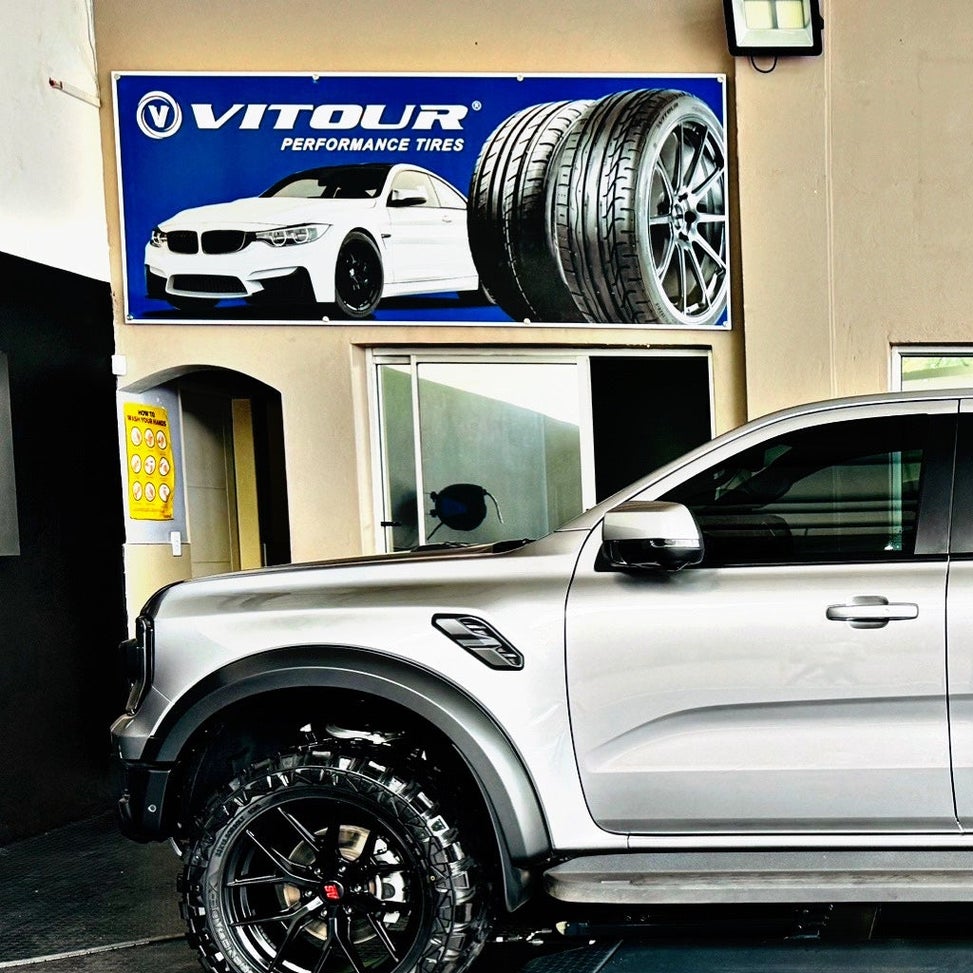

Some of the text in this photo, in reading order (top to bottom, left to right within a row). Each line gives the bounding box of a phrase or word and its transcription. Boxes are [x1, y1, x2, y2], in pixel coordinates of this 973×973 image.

[191, 104, 469, 130] VITOUR
[281, 137, 465, 152] PERFORMANCE TIRES
